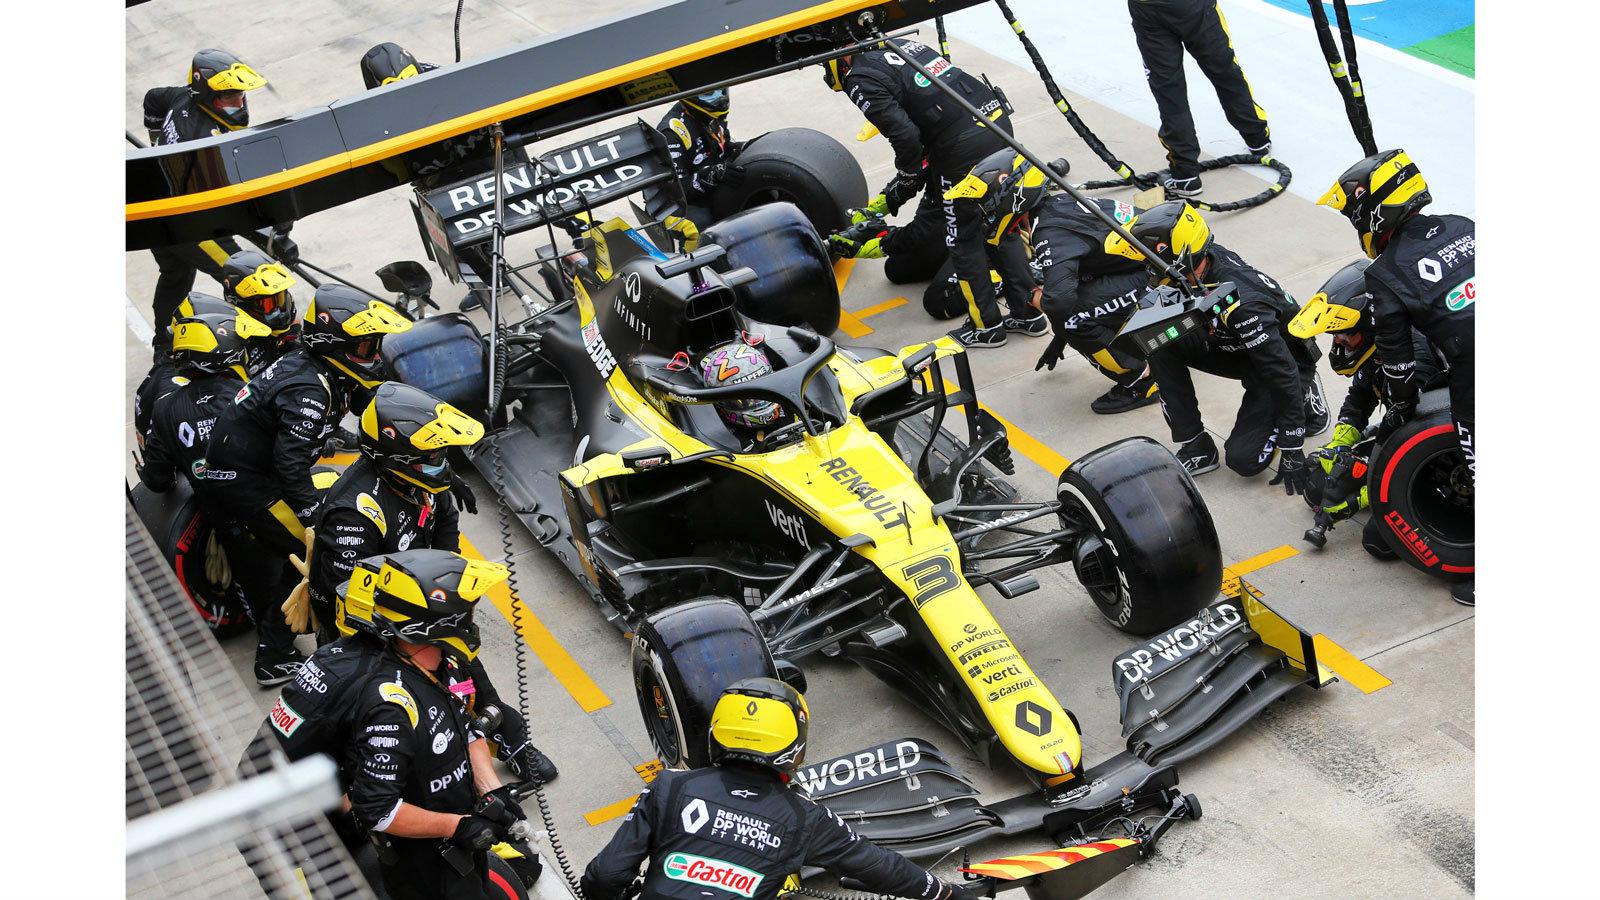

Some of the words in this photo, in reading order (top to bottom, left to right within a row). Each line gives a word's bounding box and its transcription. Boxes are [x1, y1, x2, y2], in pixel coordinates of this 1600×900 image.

[448, 135, 621, 212] RENAULT
[507, 164, 643, 216] WORLD
[1442, 250, 1457, 263] DP
[614, 295, 651, 341] INFINITI
[586, 333, 618, 379] EDGE
[820, 457, 912, 530] RENAULT
[764, 499, 811, 551] verti
[1384, 510, 1440, 568] PIRELLI
[901, 553, 962, 611] 3
[1116, 566, 1133, 627] ZERO
[951, 641, 964, 653] DP
[965, 628, 1002, 644] WORLD
[958, 639, 1011, 666] PIRELLI
[1116, 649, 1153, 683] DP
[1149, 604, 1241, 662] WORLD
[982, 664, 1022, 685] verti
[999, 679, 1035, 697] Castrol
[430, 774, 452, 793] DP
[796, 741, 921, 794] WORLD
[713, 817, 734, 831] DP
[736, 823, 781, 848] WORLD
[716, 809, 771, 831] RENAULT
[687, 860, 756, 894] Castrol
